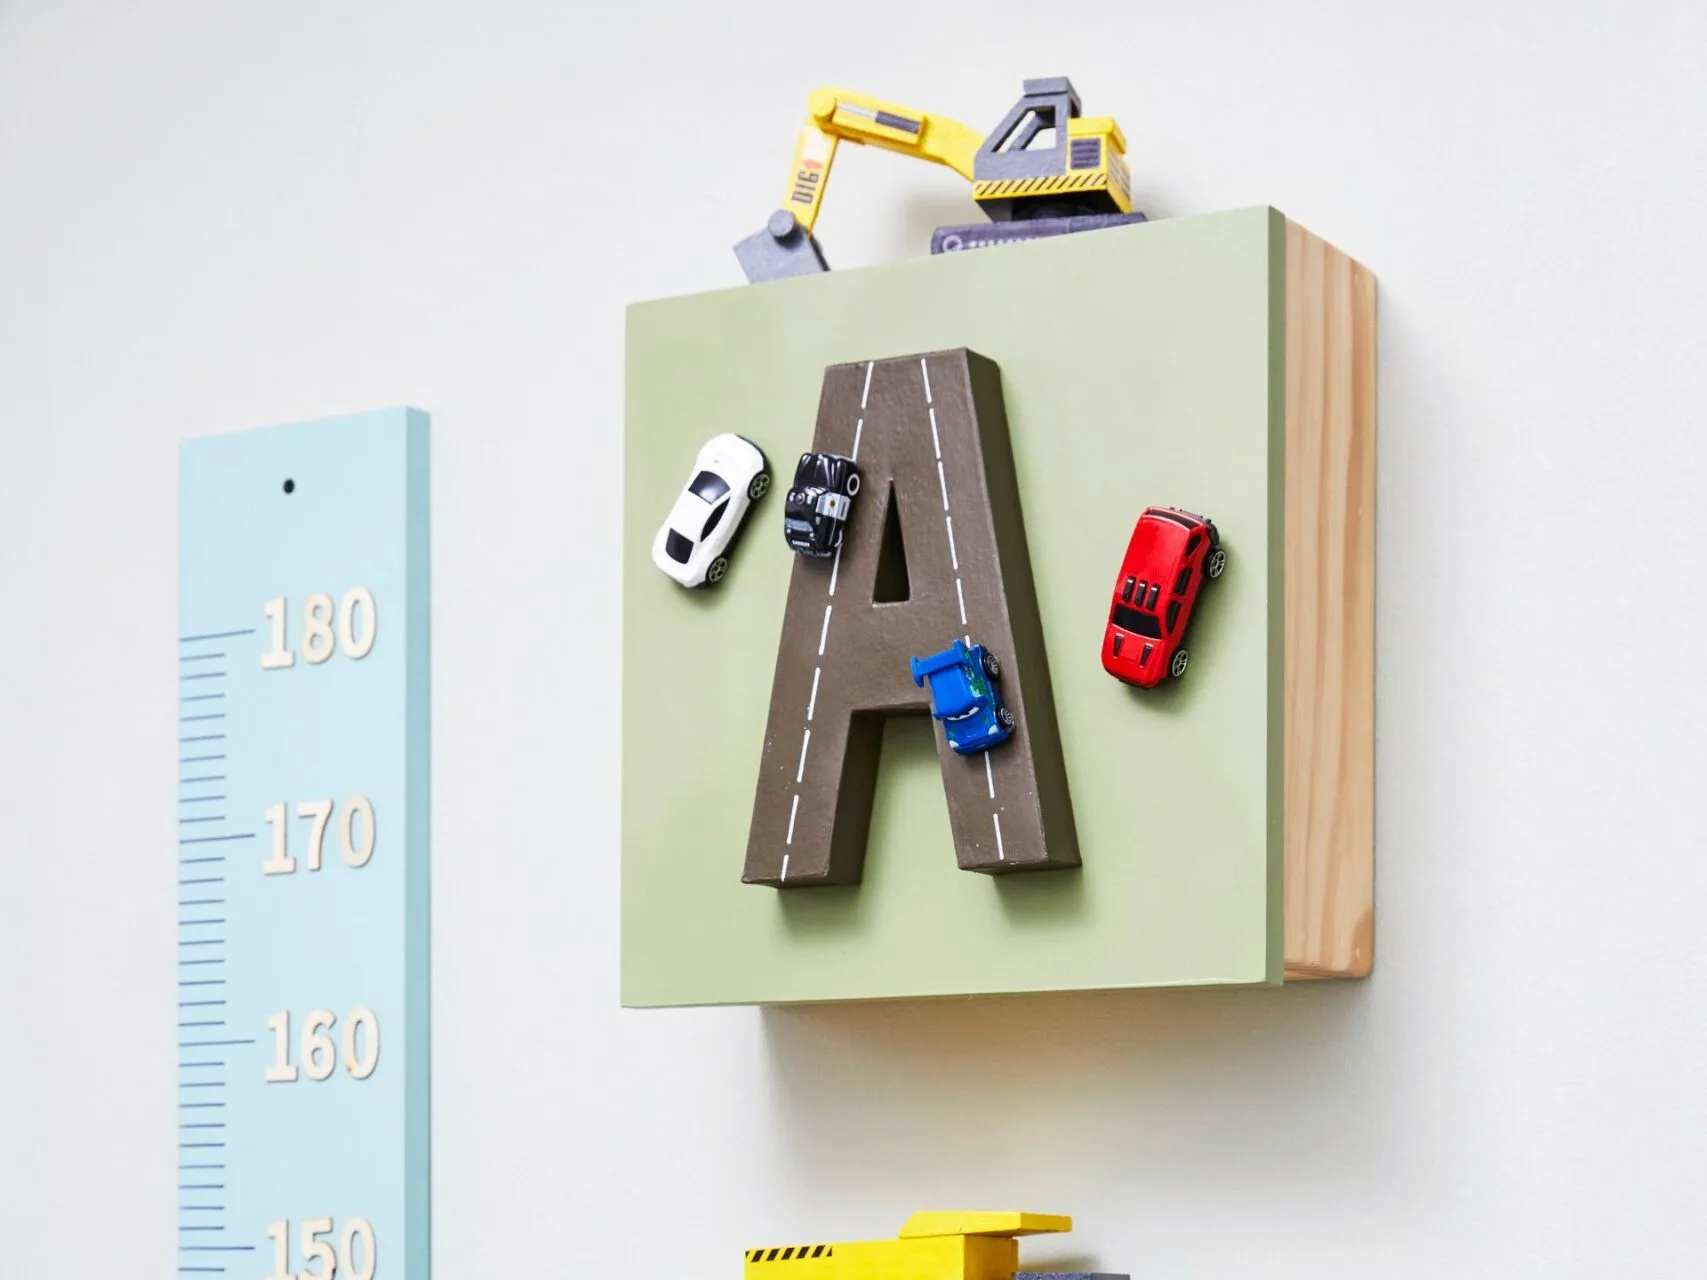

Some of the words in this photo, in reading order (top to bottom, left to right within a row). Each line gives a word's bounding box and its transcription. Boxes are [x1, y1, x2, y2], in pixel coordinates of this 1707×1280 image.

[261, 585, 376, 669] 180
[742, 347, 1081, 888] A
[262, 794, 376, 876] 170
[264, 1006, 380, 1083] 160
